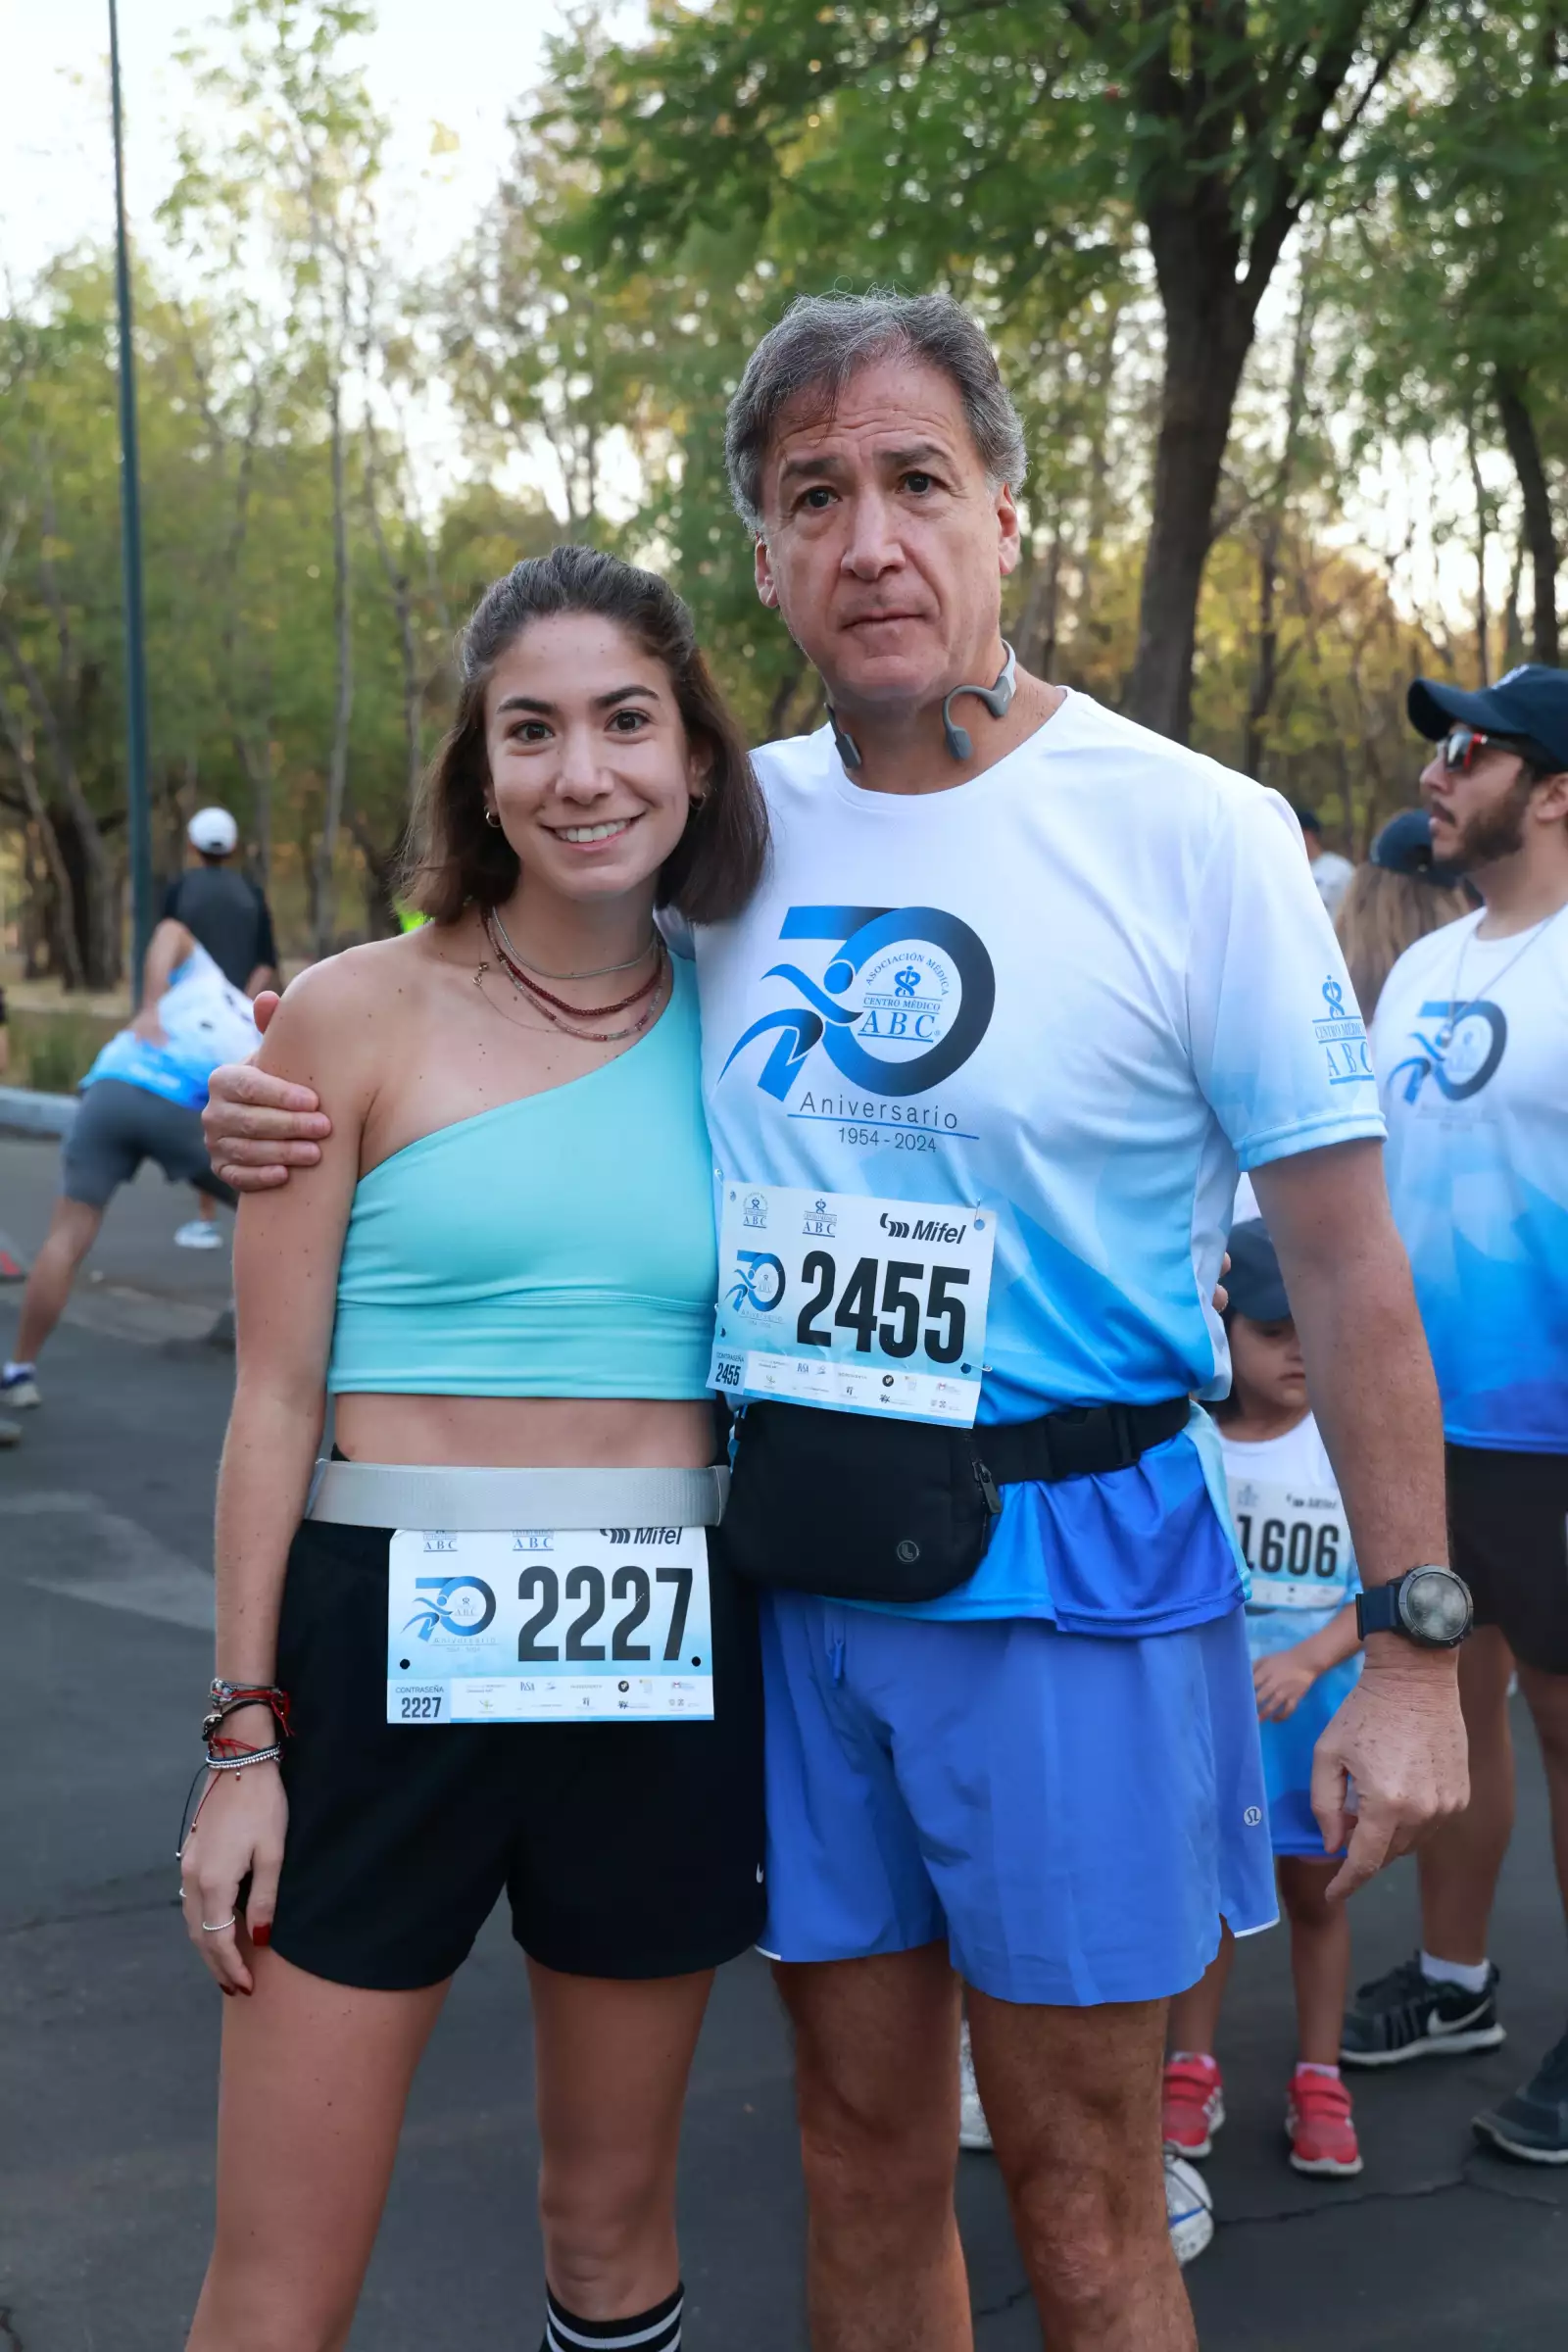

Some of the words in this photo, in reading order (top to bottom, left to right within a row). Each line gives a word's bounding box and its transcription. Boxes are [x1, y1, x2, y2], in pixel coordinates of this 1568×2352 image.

[865, 953, 925, 986] ASOCIACIÓN
[926, 958, 950, 996] MÉDICA
[863, 997, 901, 1007] CENTRO
[903, 999, 941, 1011] MÉDICO
[859, 1010, 935, 1039] ABC
[1315, 1022, 1342, 1040] CENTRO
[800, 1092, 958, 1130] Aniversario
[743, 1215, 765, 1226] ABC
[803, 1220, 837, 1235] ABC
[911, 1218, 967, 1245] Mifel
[797, 1250, 971, 1364] 2455
[715, 1362, 741, 1387] 2455
[424, 1540, 455, 1550] ABC
[514, 1536, 553, 1549] ABC
[633, 1526, 681, 1545] Mifel
[1237, 1513, 1340, 1578] 1606
[517, 1565, 693, 1662] 2227
[395, 1685, 444, 1694] CONTRASEÑA
[401, 1696, 442, 1719] 2227
